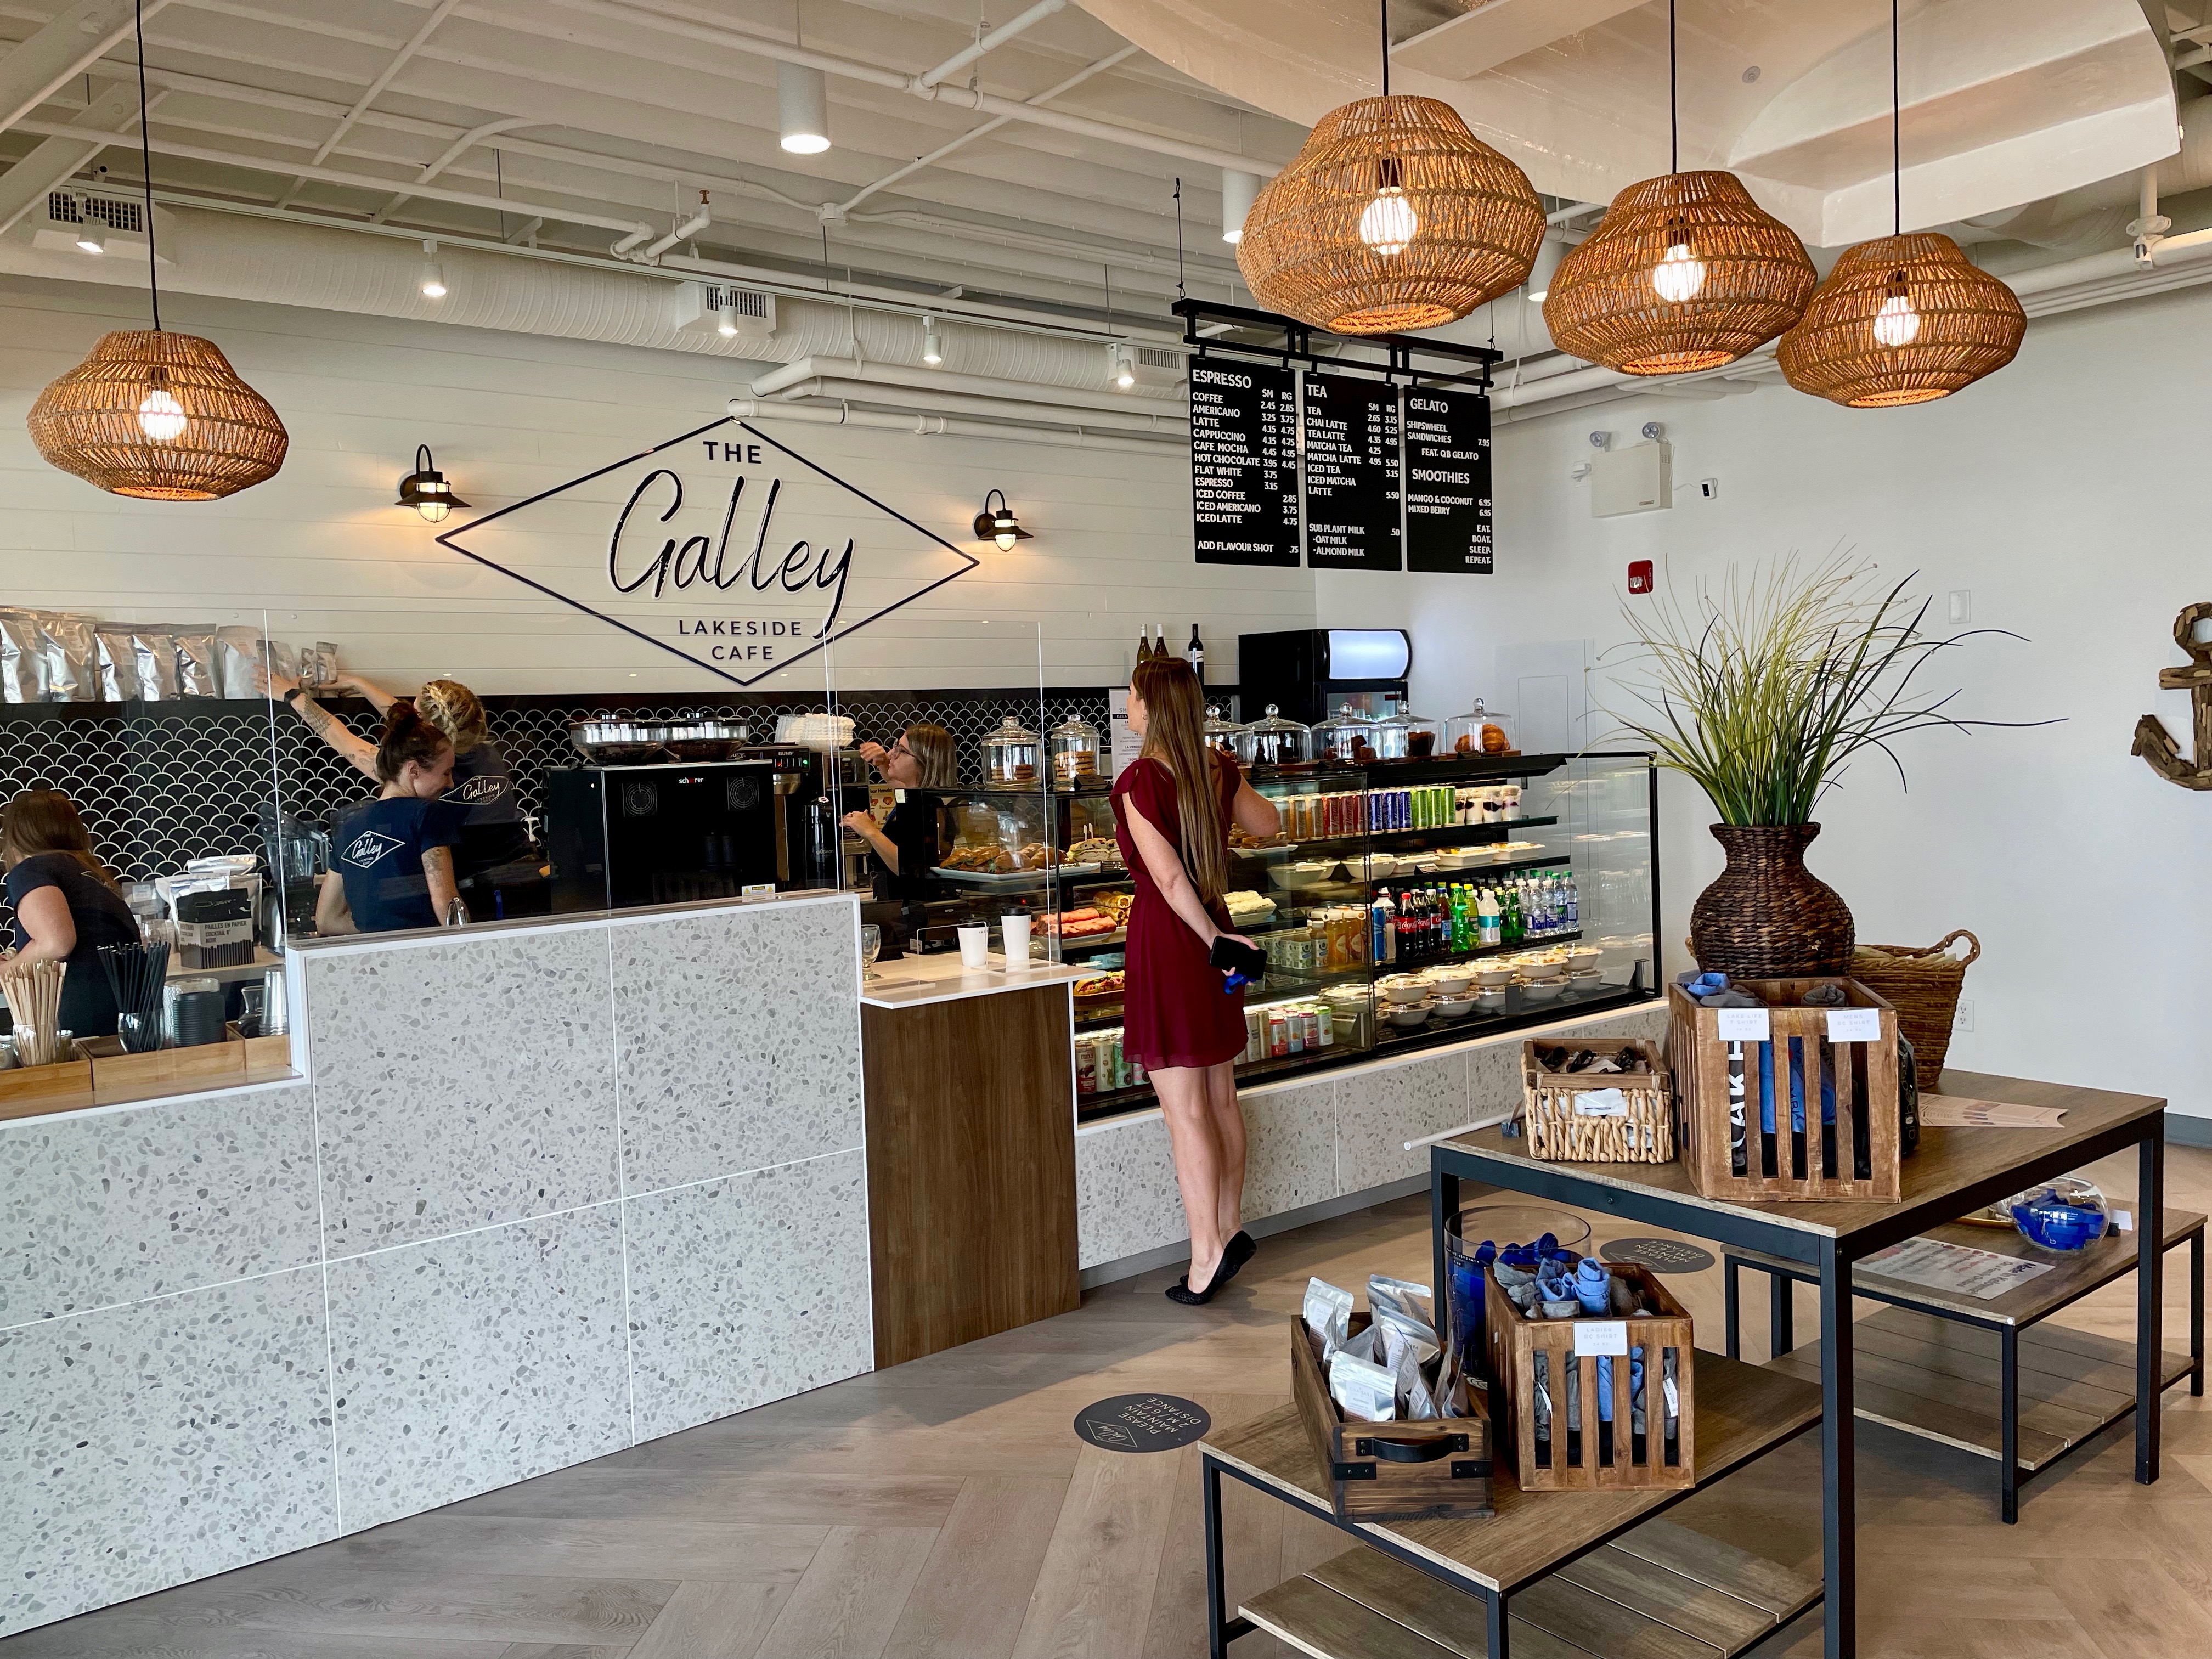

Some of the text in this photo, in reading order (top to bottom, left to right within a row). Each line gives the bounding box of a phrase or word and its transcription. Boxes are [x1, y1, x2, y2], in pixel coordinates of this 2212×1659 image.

[1193, 369, 1251, 388] ESPRESSO
[1262, 389, 1292, 400] SM RG
[1306, 384, 1327, 398] TEA
[1193, 392, 1294, 412] COFFEE 2.45 2.85
[1368, 403, 1379, 411] SM
[1410, 398, 1448, 413] GELATO
[1193, 404, 1240, 417] AMERICANO
[1280, 415, 1294, 424] 3.75
[1307, 406, 1322, 415] TEA
[1193, 416, 1220, 427] LATTE
[1307, 418, 1324, 427] CHAI
[1326, 420, 1347, 431] LATTE
[1407, 421, 1448, 432] SHIPSWHEEL
[1193, 429, 1295, 446] CAPPUCCINO 4.15 4.75
[1307, 429, 1322, 438] TEA
[1323, 431, 1345, 441] LATTE
[1408, 432, 1451, 443] SANDWICHES
[703, 441, 761, 464] THE
[1194, 441, 1295, 458] CAFE MOCHA 4.45 4.95
[1307, 441, 1336, 451] MATCHA
[1338, 443, 1352, 452] TEA
[1195, 454, 1211, 462] HOT
[1213, 455, 1260, 466] CHOCOLATE
[1263, 459, 1277, 467] 3.95
[1307, 453, 1337, 462] MATCHA
[1340, 455, 1361, 464] LATTE
[1422, 448, 1438, 456] FEAT.
[1453, 451, 1479, 460] GELATO
[1195, 466, 1277, 479] FLAT WHITE 3.75
[1308, 464, 1325, 473] ICED
[1326, 465, 1341, 474] TEA
[1308, 476, 1356, 486] ICED MATCHA
[1412, 469, 1469, 484] SMOOTHIES
[1195, 477, 1278, 490] ESPRESSO 3.15
[1196, 489, 1214, 498] ICED
[1216, 490, 1245, 500] COFFEE
[1308, 486, 1332, 496] LATTE
[1408, 494, 1433, 503] MANGO
[1441, 496, 1473, 505] COCONUT
[1197, 501, 1297, 514] ICED AMERICANO 3.75
[1430, 506, 1450, 515] BERRY
[1197, 514, 1216, 522] ICED
[1217, 515, 1242, 523] LATTE
[1309, 523, 1323, 532] SUB
[1324, 524, 1347, 533] PLANT
[1348, 526, 1365, 534] MILK
[1472, 535, 1491, 543] BOAT.
[1198, 541, 1215, 549] ADD
[1217, 542, 1251, 551] FLAVOUR
[1253, 543, 1274, 552] SHOT
[610, 469, 853, 639] Galley
[679, 620, 802, 635] LAKESIDE
[712, 646, 773, 660] CAFE
[463, 779, 500, 800] Galley
[352, 837, 382, 860] Galley
[1649, 1240, 1705, 1257] DISTANCE
[1634, 1249, 1677, 1263] PLEASE
[1146, 1397, 1201, 1425] DISTANCE
[1118, 1412, 1161, 1434] PLEASE
[1125, 1405, 1178, 1433] MAINTAIN
